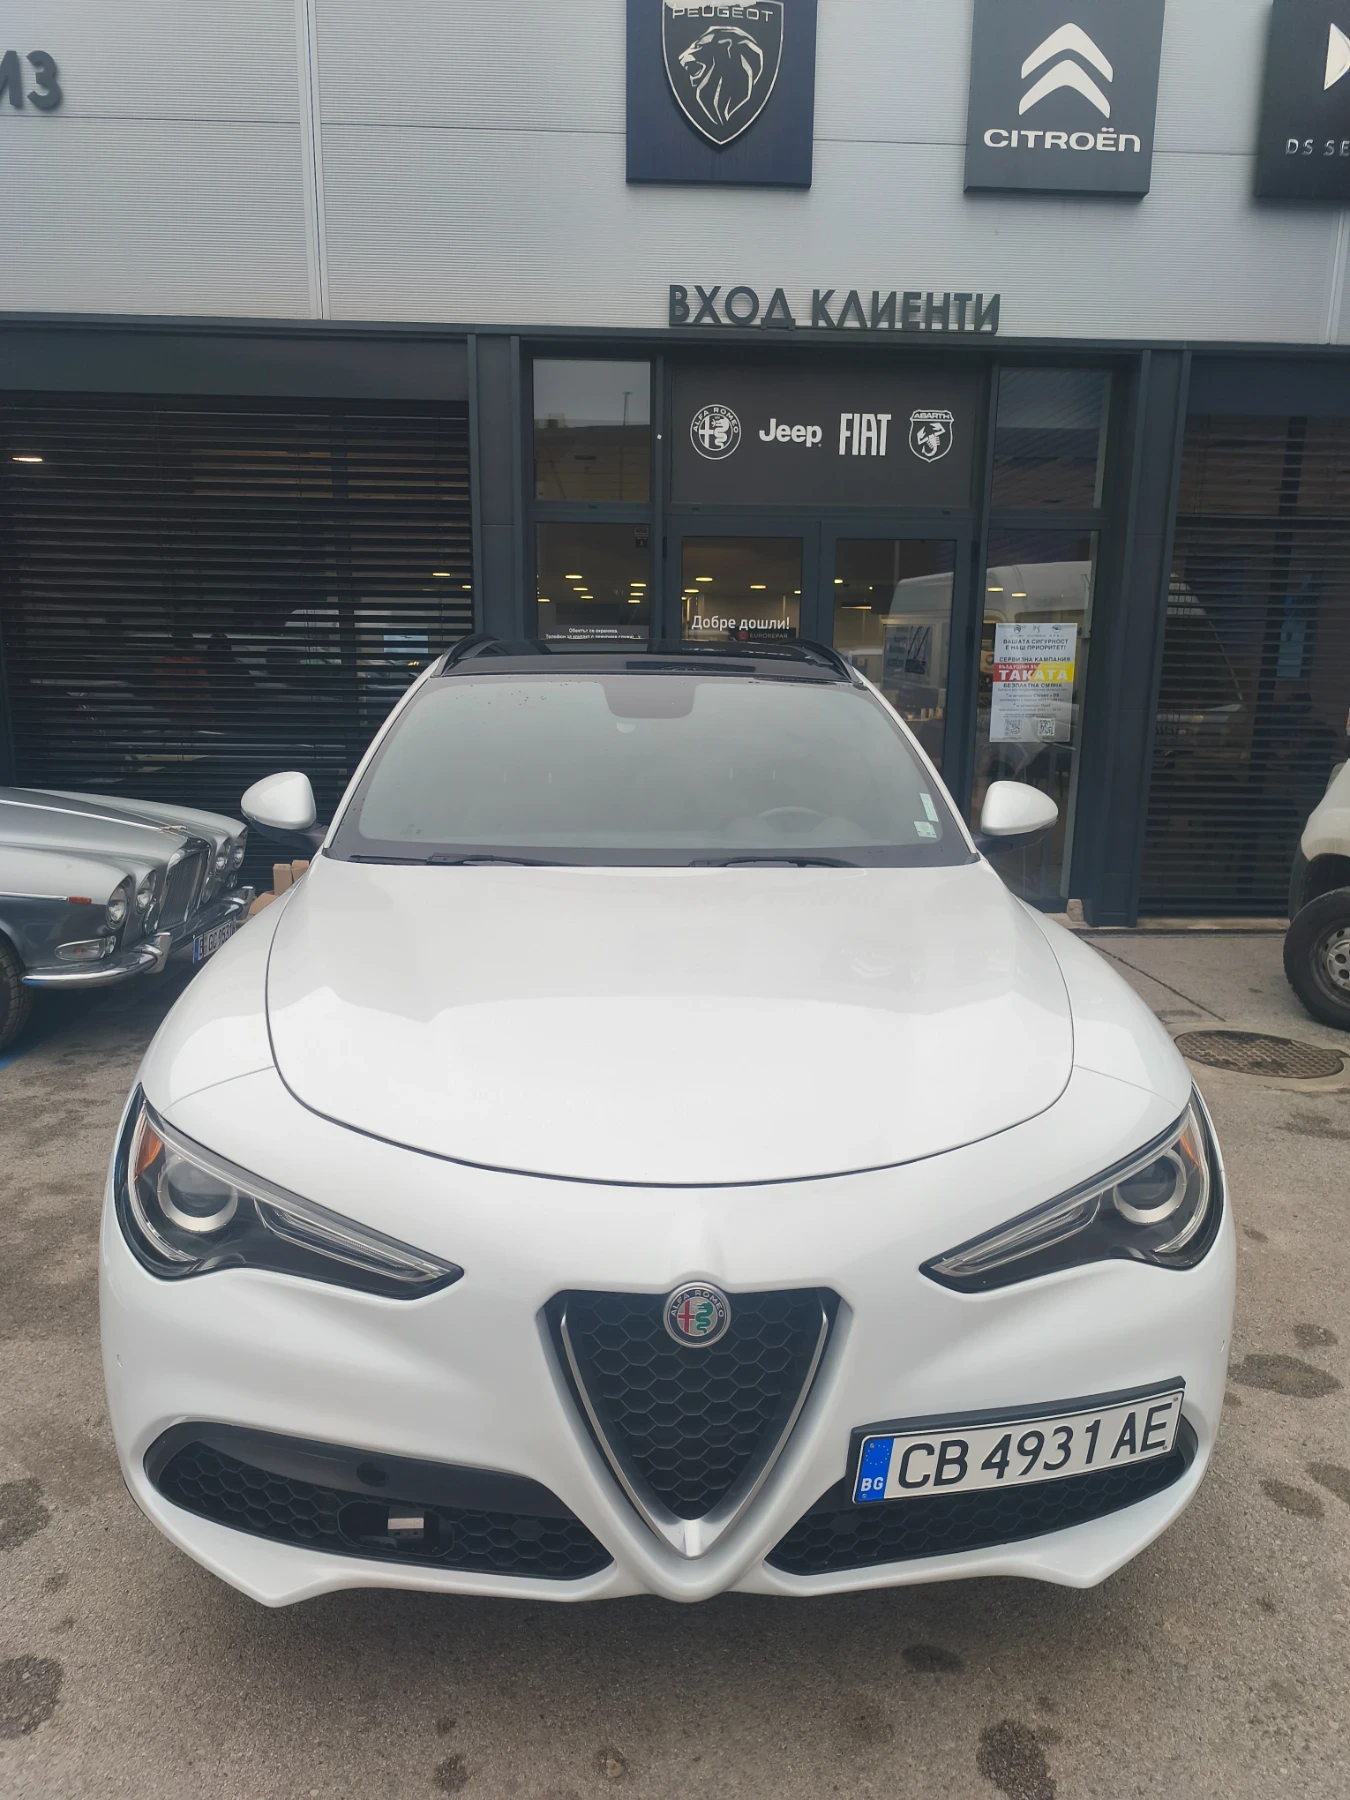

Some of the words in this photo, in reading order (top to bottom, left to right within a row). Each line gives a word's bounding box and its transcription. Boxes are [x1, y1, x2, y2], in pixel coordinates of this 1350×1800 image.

[672, 5, 774, 21] PEUGEOT
[1286, 138, 1313, 156] DS
[669, 285, 796, 330] ВХОД
[812, 289, 1001, 332] КЛИЕНТИ
[693, 409, 710, 432] ALFA
[713, 407, 739, 433] ROMEO
[913, 412, 950, 420] ABARTH
[759, 418, 823, 447] Jeep
[839, 413, 892, 456] FIAT
[692, 615, 736, 631] Добре
[739, 616, 790, 631] дошли!
[999, 670, 1068, 681] ТАКАТА
[671, 1293, 690, 1317] ALFA
[694, 1289, 724, 1318] ROMEO
[898, 1439, 969, 1489] CB
[980, 1418, 1101, 1480] 4931
[1110, 1402, 1173, 1459] AE
[861, 1476, 884, 1492] BG
